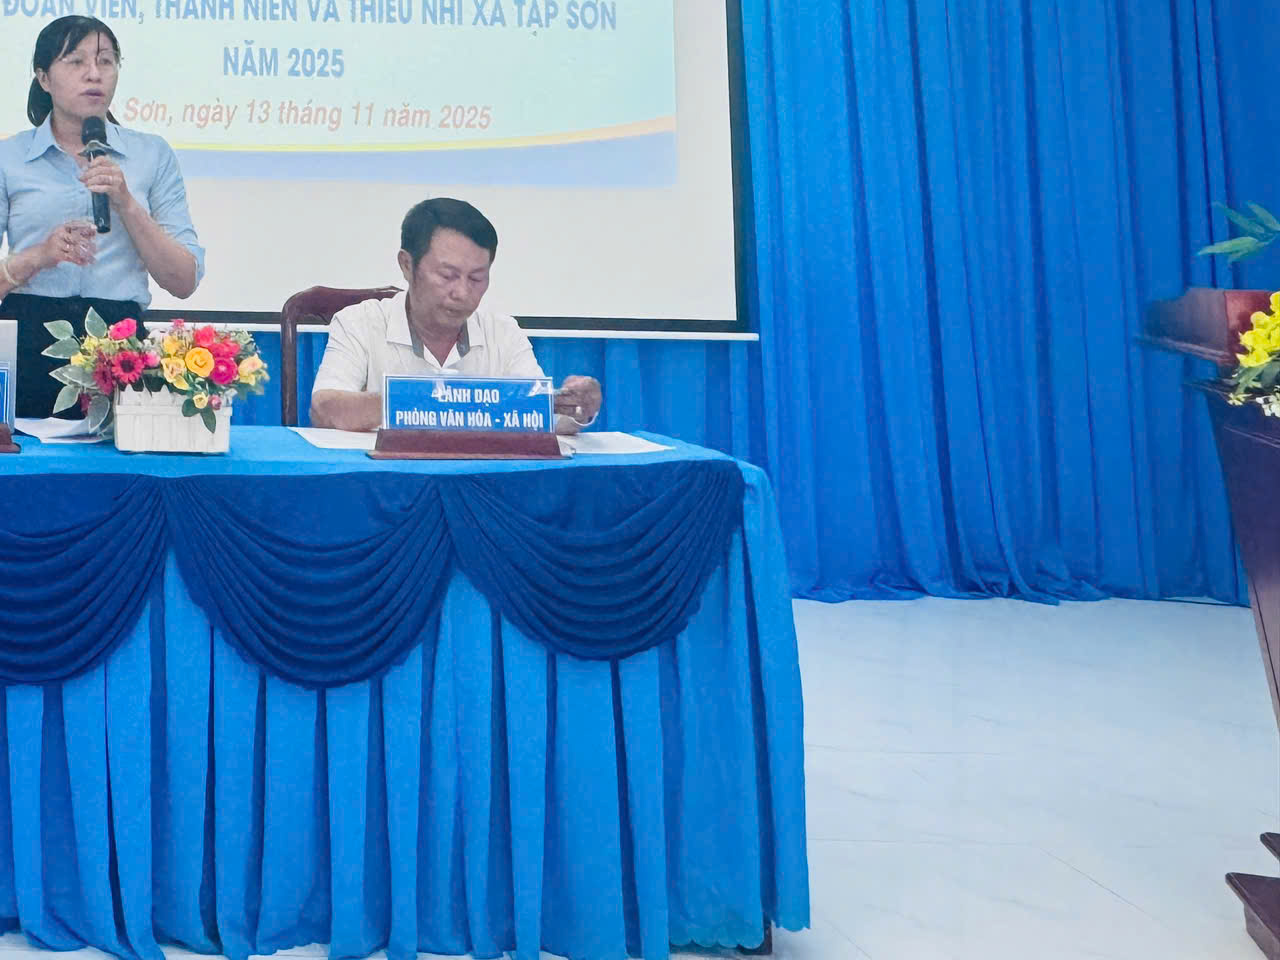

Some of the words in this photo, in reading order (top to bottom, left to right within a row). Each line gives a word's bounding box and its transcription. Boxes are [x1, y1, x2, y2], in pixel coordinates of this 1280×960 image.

[222, 40, 279, 77] NĂM
[287, 47, 345, 78] 2025
[124, 96, 172, 126] Sơn,
[182, 97, 238, 130] ngày
[246, 100, 271, 123] 13
[278, 99, 342, 132] tháng
[351, 102, 374, 126] 11
[383, 102, 431, 128] năm
[438, 105, 492, 129] 2025
[474, 389, 499, 407] ĐẠO
[395, 408, 436, 426] PHÒNG
[440, 408, 464, 427] VĂN
[467, 409, 492, 427] HÓA
[503, 411, 520, 427] XÃ
[523, 410, 544, 431] HỘI
